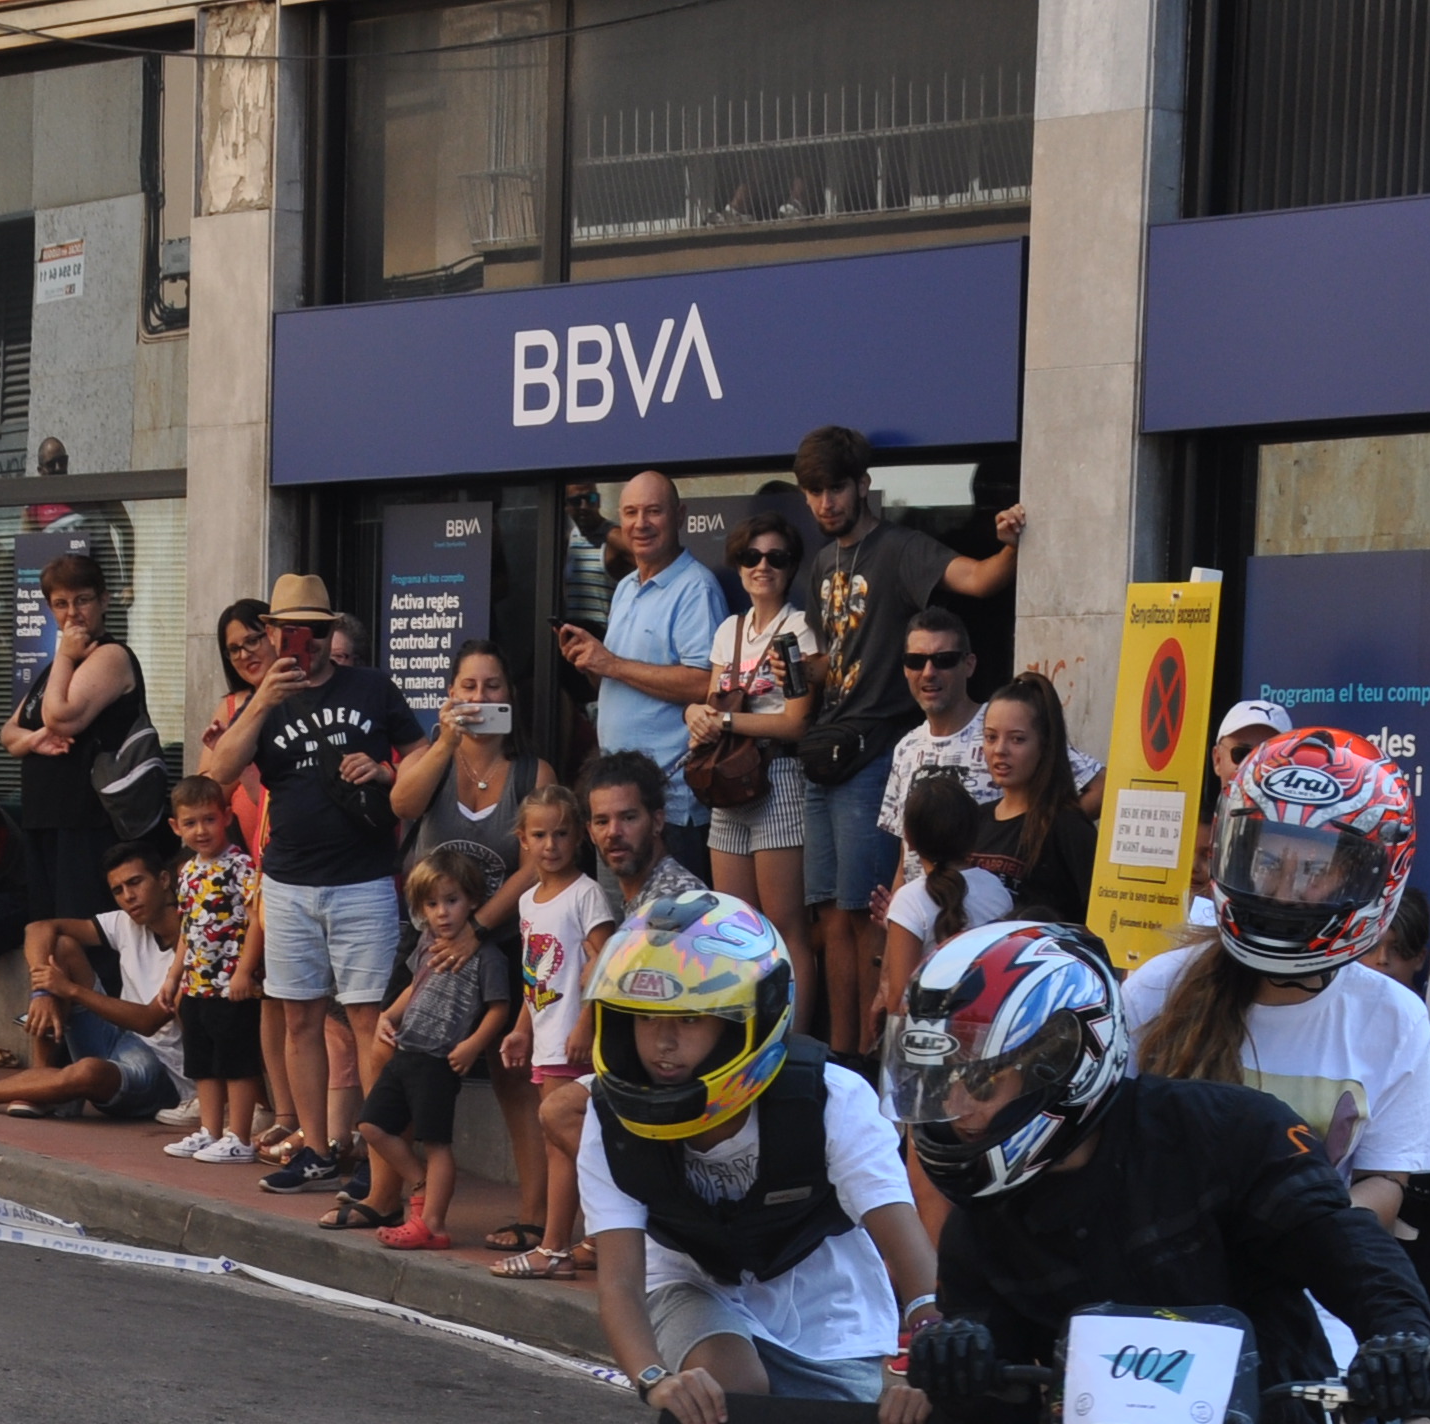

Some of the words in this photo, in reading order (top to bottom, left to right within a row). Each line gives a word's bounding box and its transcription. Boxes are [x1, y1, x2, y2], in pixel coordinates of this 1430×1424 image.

[513, 302, 724, 427] BBVA
[446, 517, 481, 538] BBVA
[687, 513, 725, 533] BBVA
[391, 593, 424, 611] Activa
[426, 592, 460, 613] regles
[390, 616, 408, 634] per
[410, 611, 457, 630] estalviar
[459, 612, 463, 629] i
[389, 633, 439, 650] controlar
[441, 632, 451, 649] el
[389, 654, 408, 669] teu
[409, 653, 451, 673] compte
[404, 676, 445, 689] manera
[1260, 684, 1335, 707] Programa
[1339, 683, 1354, 702] el
[1357, 684, 1384, 703] teu
[1268, 770, 1331, 795] Arai
[629, 972, 667, 999] LEM
[905, 1034, 946, 1050] HJC
[1110, 1344, 1189, 1384] 002
